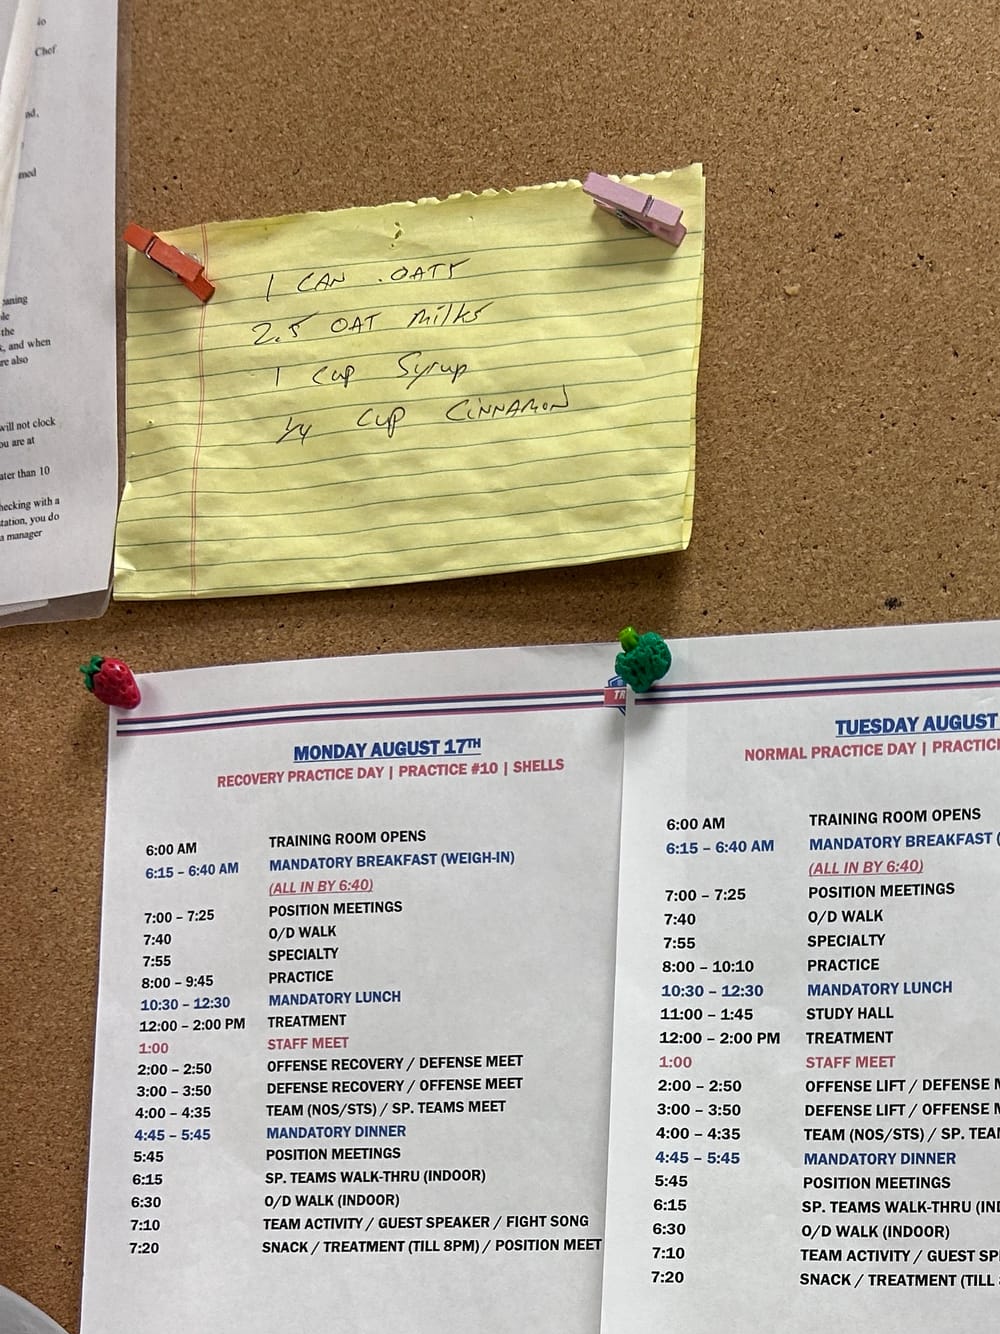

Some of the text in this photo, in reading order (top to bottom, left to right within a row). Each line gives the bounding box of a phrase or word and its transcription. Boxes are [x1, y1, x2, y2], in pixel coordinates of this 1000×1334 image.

[34, 45, 57, 57] Chef
[252, 312, 319, 346] 2.5
[330, 312, 383, 333] OAT
[9, 338, 51, 352] and when
[17, 417, 56, 430] not clock
[18, 466, 50, 478] than 10
[33, 497, 53, 507] with
[30, 512, 60, 526] you do
[7, 529, 43, 543] manager
[836, 717, 920, 739] TUESDAY
[923, 713, 998, 735] AUGUST
[293, 741, 368, 763] MONDAY
[371, 739, 440, 760] AUGUST
[268, 829, 427, 849] TRAINING ROOM OPENS
[145, 841, 197, 857] 6:00 AM
[807, 933, 886, 948] SPECIALTY
[268, 990, 401, 1007] MANDATORY LUNCH
[806, 1006, 895, 1021] STUDY HALL
